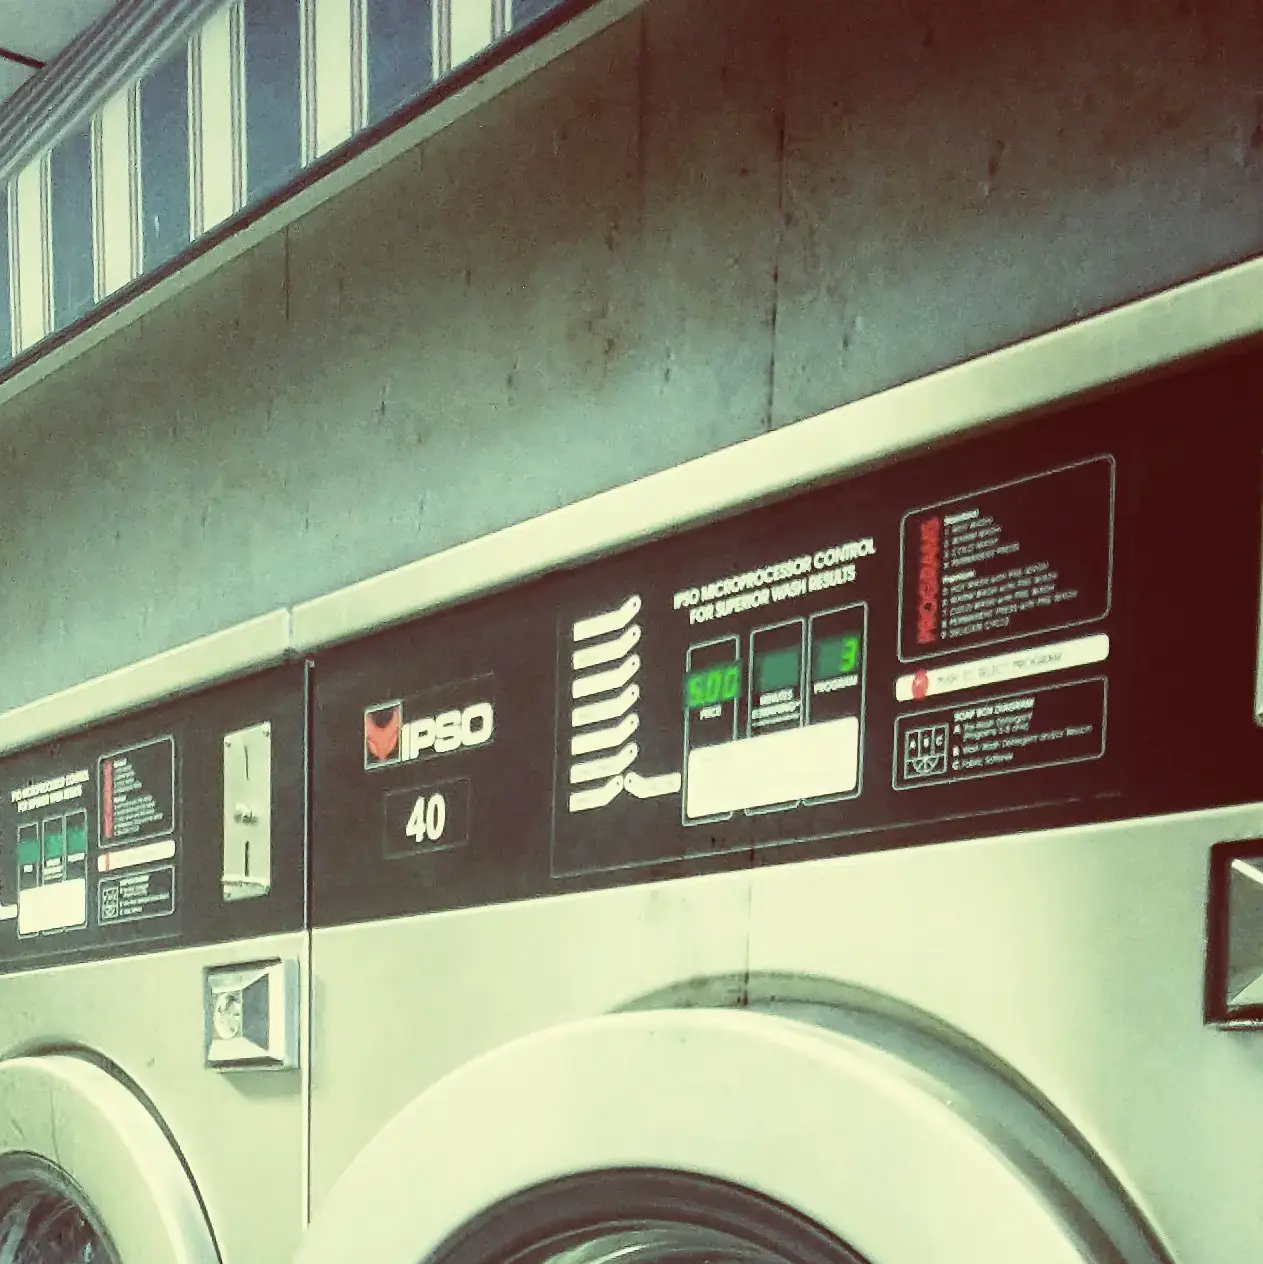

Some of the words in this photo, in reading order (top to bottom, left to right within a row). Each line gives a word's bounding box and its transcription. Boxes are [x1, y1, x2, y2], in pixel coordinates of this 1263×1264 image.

[690, 602, 714, 625] FOR
[715, 587, 770, 619] SUPERIOR
[771, 577, 808, 603] WASH
[808, 563, 856, 593] RESULTS
[701, 554, 812, 602] MICROPROCESSOR
[813, 537, 876, 570] CONTROL
[839, 635, 860, 673] 3
[400, 702, 494, 761] IPSO
[405, 793, 446, 842] 40
